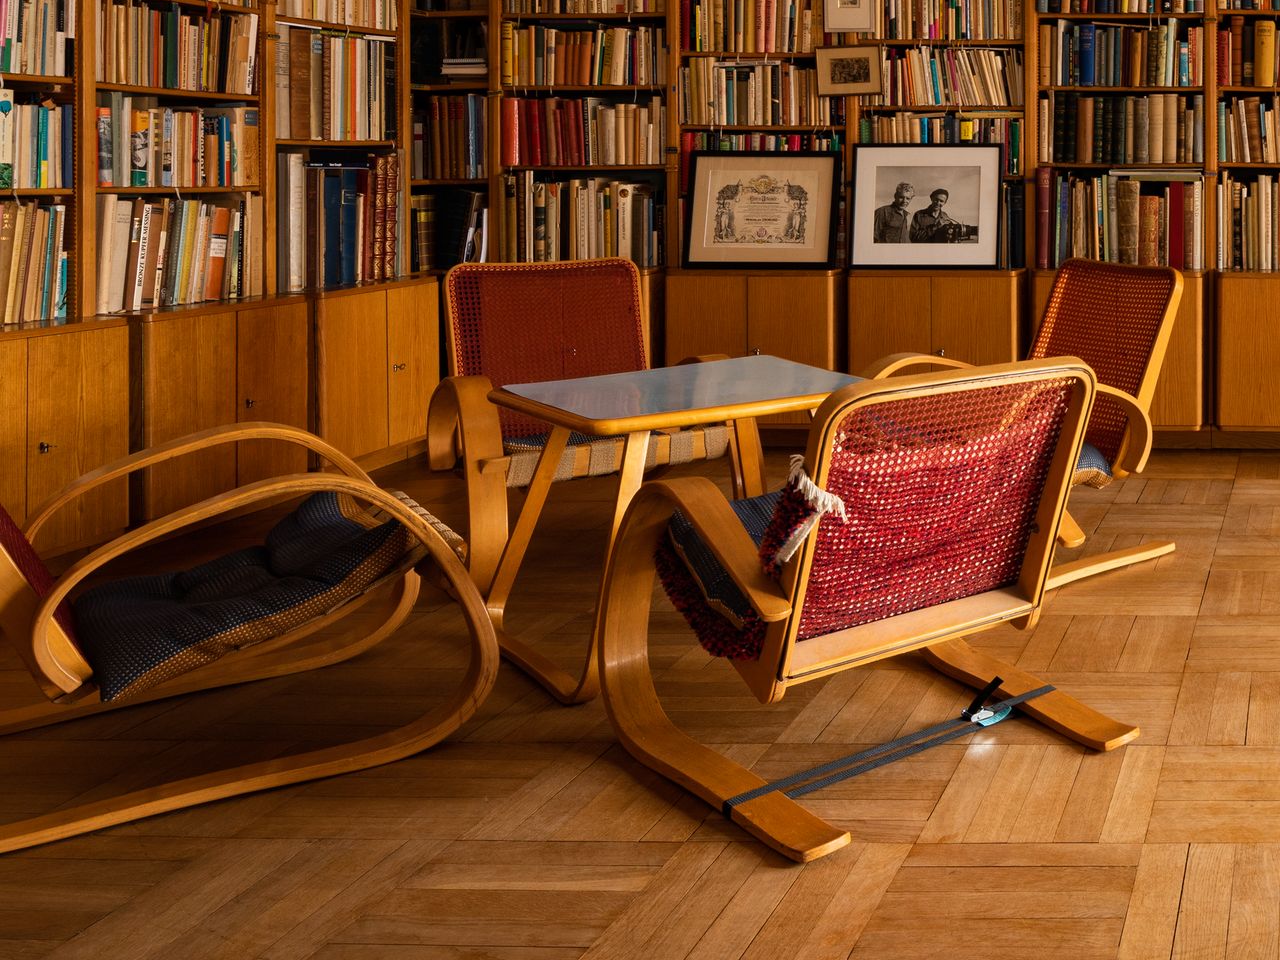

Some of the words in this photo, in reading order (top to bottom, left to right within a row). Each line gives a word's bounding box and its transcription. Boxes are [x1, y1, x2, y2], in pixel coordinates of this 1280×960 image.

[141, 207, 151, 235] MESSING
[139, 236, 148, 260] KUPFER
[137, 261, 145, 287] BRONZE
